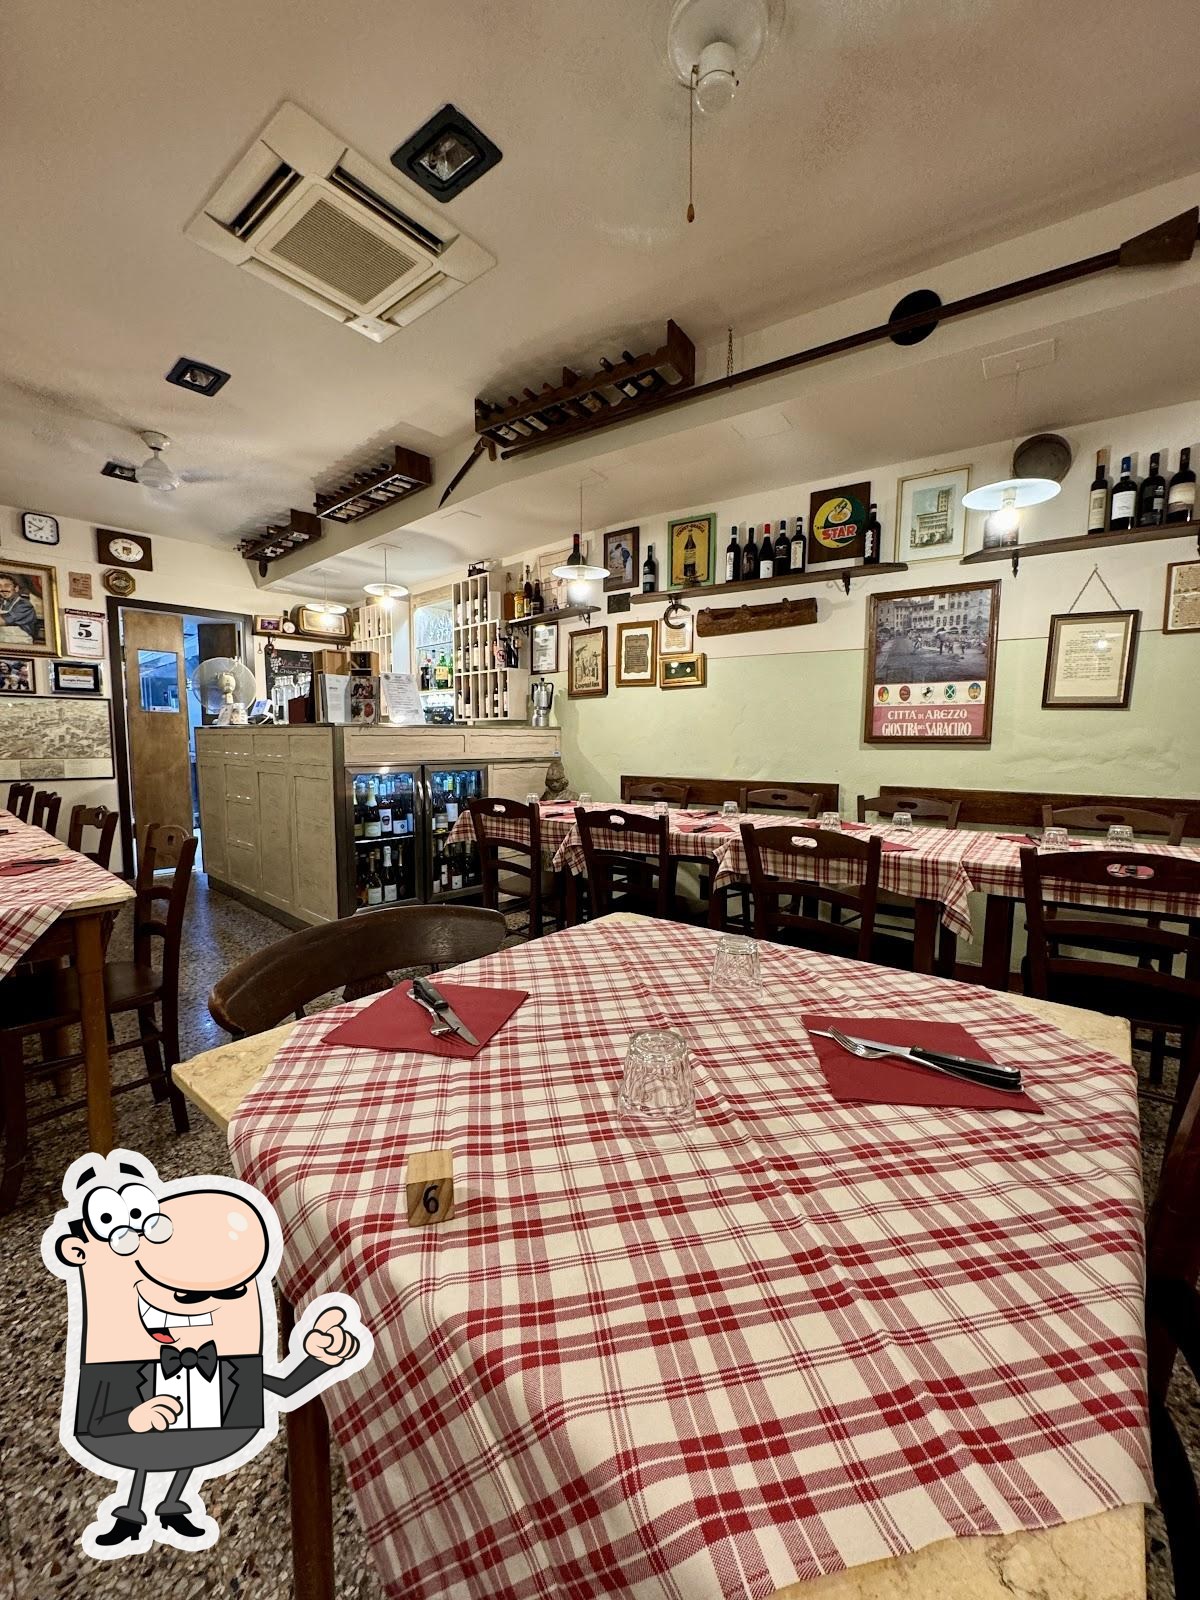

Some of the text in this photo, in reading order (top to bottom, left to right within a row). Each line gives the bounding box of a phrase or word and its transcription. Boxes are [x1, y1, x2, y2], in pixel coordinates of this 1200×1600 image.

[821, 524, 857, 541] STAR
[78, 623, 92, 638] 5
[925, 708, 968, 720] AREZZO
[881, 722, 918, 736] GIOSTRA
[423, 1184, 439, 1214] 6
